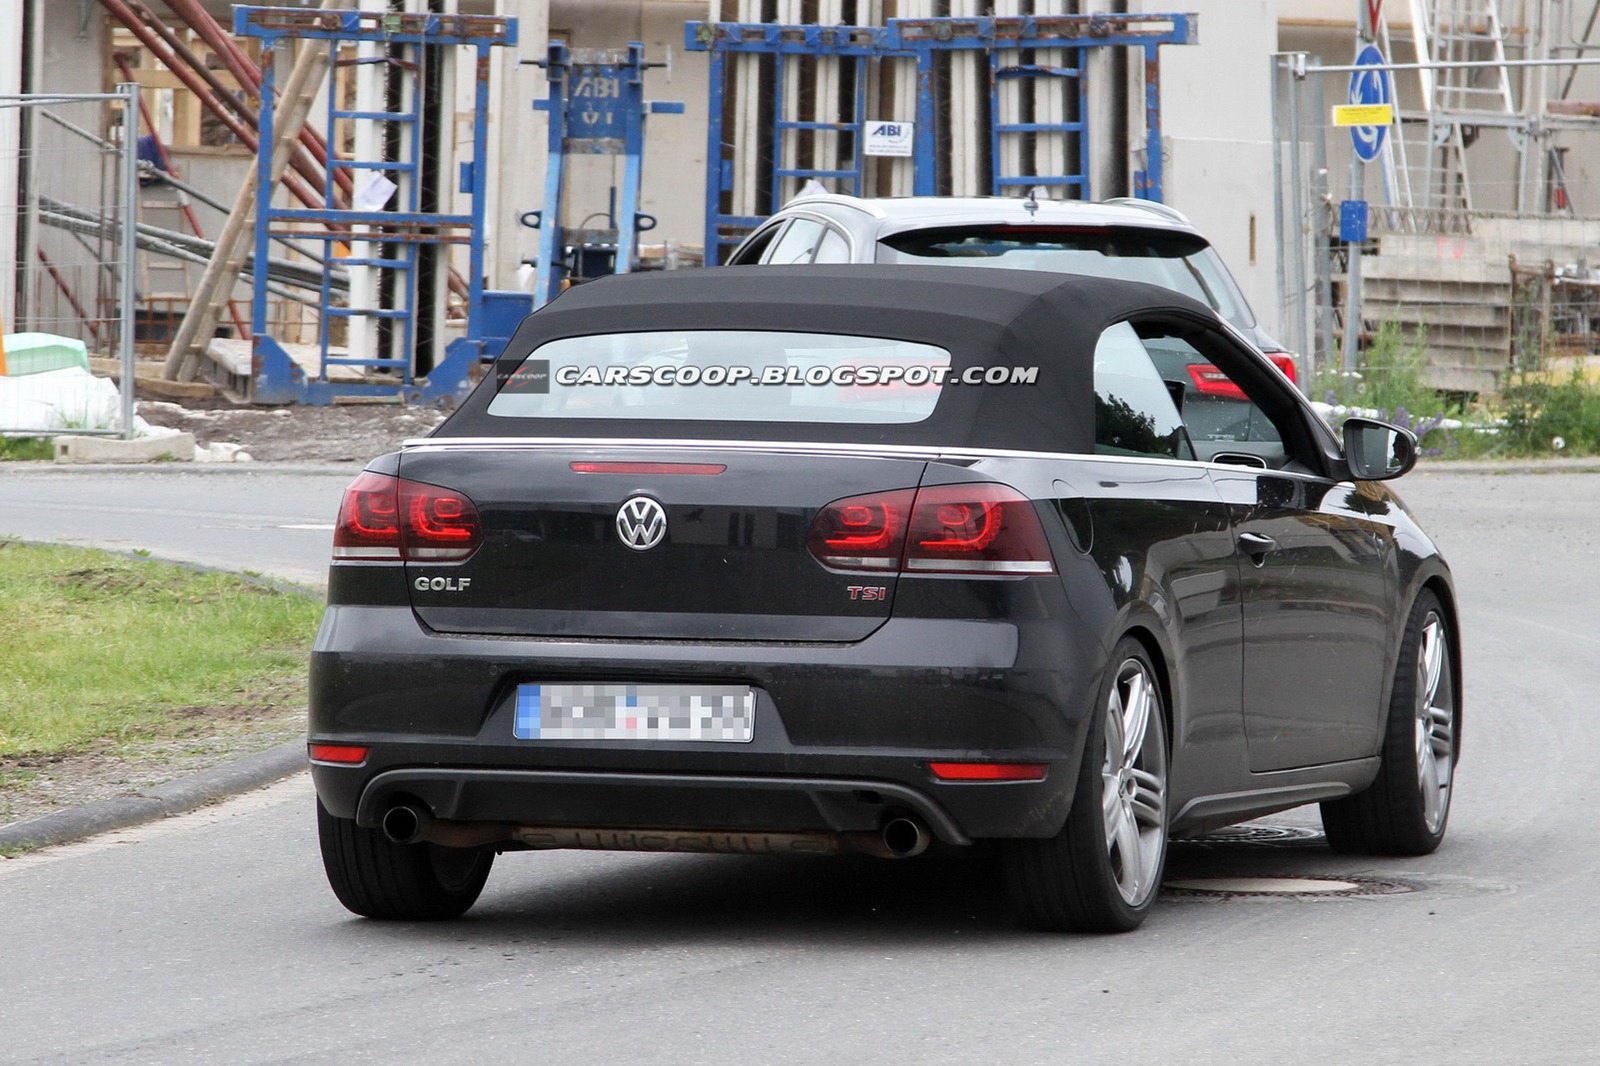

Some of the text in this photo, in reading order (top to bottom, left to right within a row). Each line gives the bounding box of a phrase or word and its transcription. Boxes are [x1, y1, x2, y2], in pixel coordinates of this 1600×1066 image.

[574, 77, 619, 98] ABI
[872, 124, 901, 136] ABI
[617, 497, 666, 549] VW
[414, 576, 471, 591] GOLF
[847, 586, 886, 600] TSI
